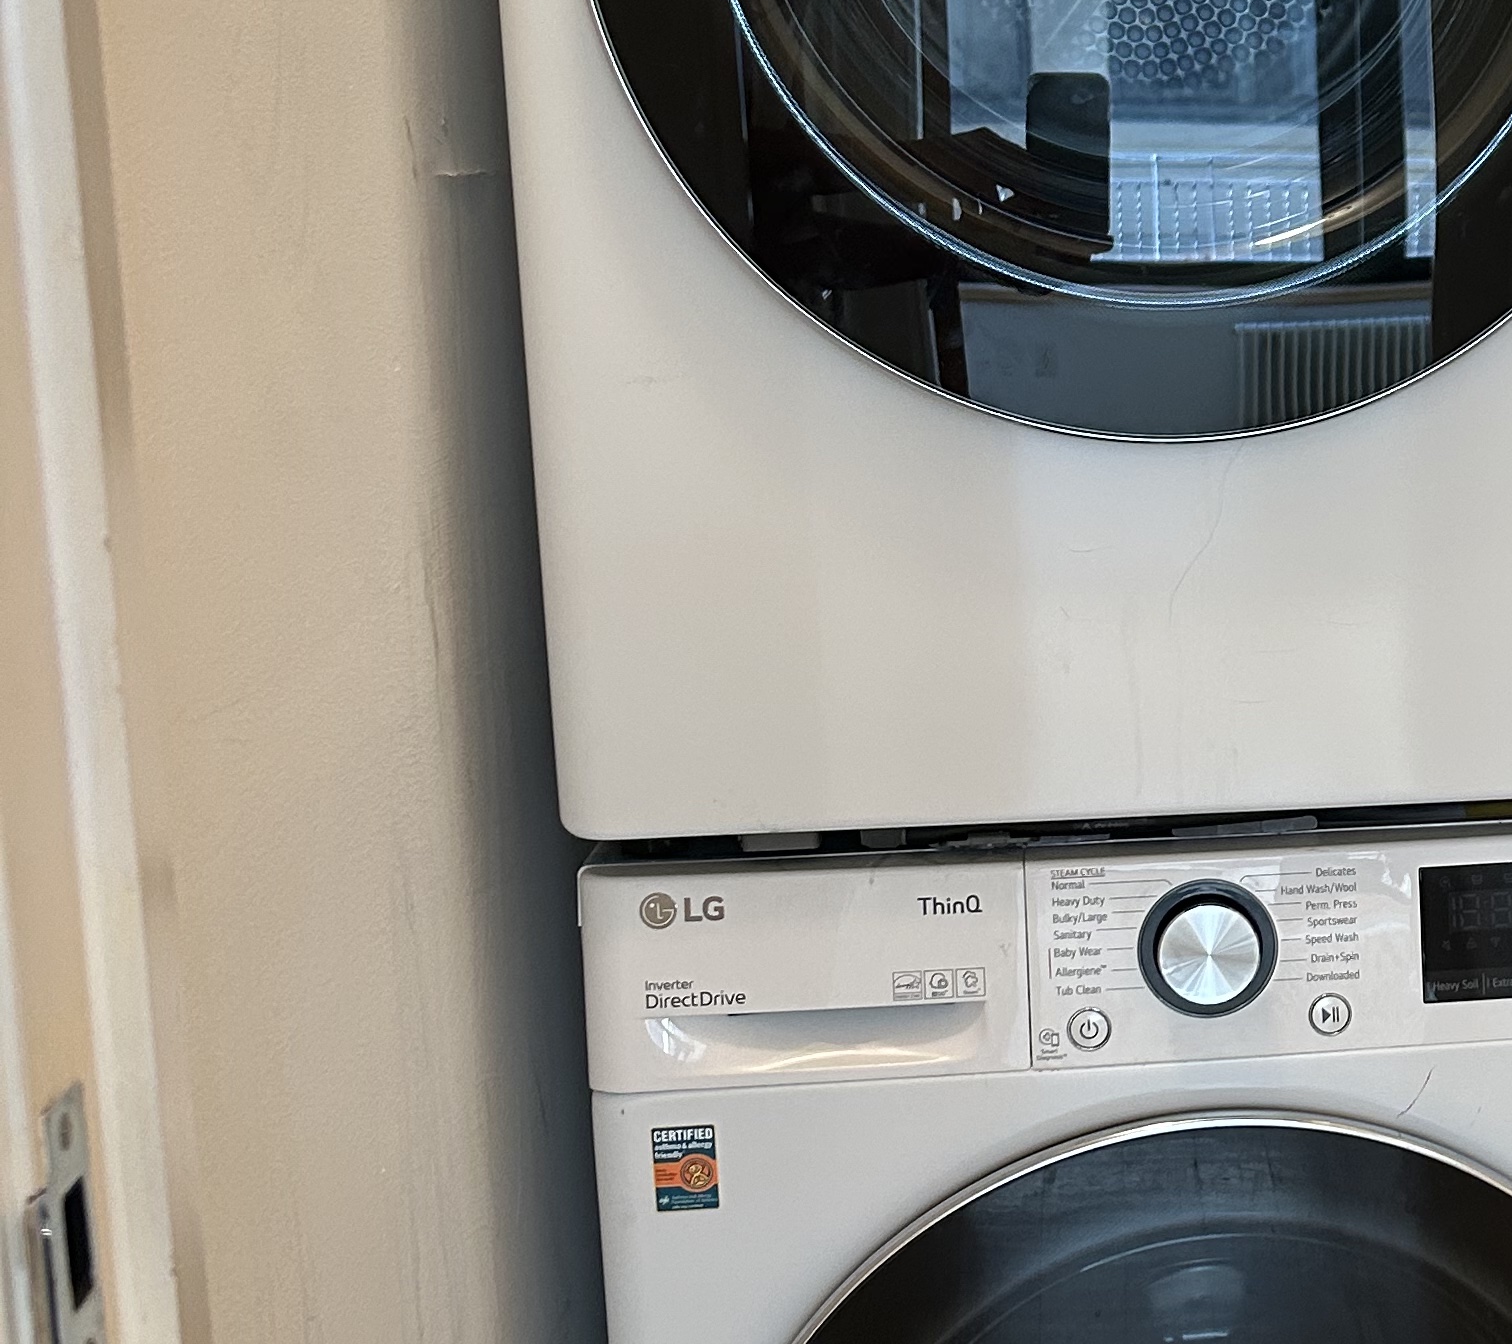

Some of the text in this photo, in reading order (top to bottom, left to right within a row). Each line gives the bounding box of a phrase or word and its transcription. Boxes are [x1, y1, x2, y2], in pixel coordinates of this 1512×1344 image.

[1315, 867, 1357, 877] Delicates
[1051, 879, 1085, 890] Normal
[1280, 882, 1357, 895] Hand Wash/Wool
[917, 895, 983, 915] ThinQ
[1052, 895, 1105, 908] Heavy Duty
[1305, 899, 1358, 910] Perm. Press
[684, 896, 725, 922] LG
[1053, 912, 1108, 926] Bulky/Large
[1307, 916, 1358, 928] Sportswear
[1053, 929, 1093, 941] Sanitary
[1305, 932, 1359, 946] Speed Wash
[1053, 947, 1102, 960] Baby Wear
[1306, 969, 1360, 982] Downloaded
[645, 980, 694, 991] Inverter
[1056, 984, 1102, 996] Tub Clean
[1433, 978, 1479, 992] Heavy Soil
[653, 1128, 713, 1143] CERTIFIED
